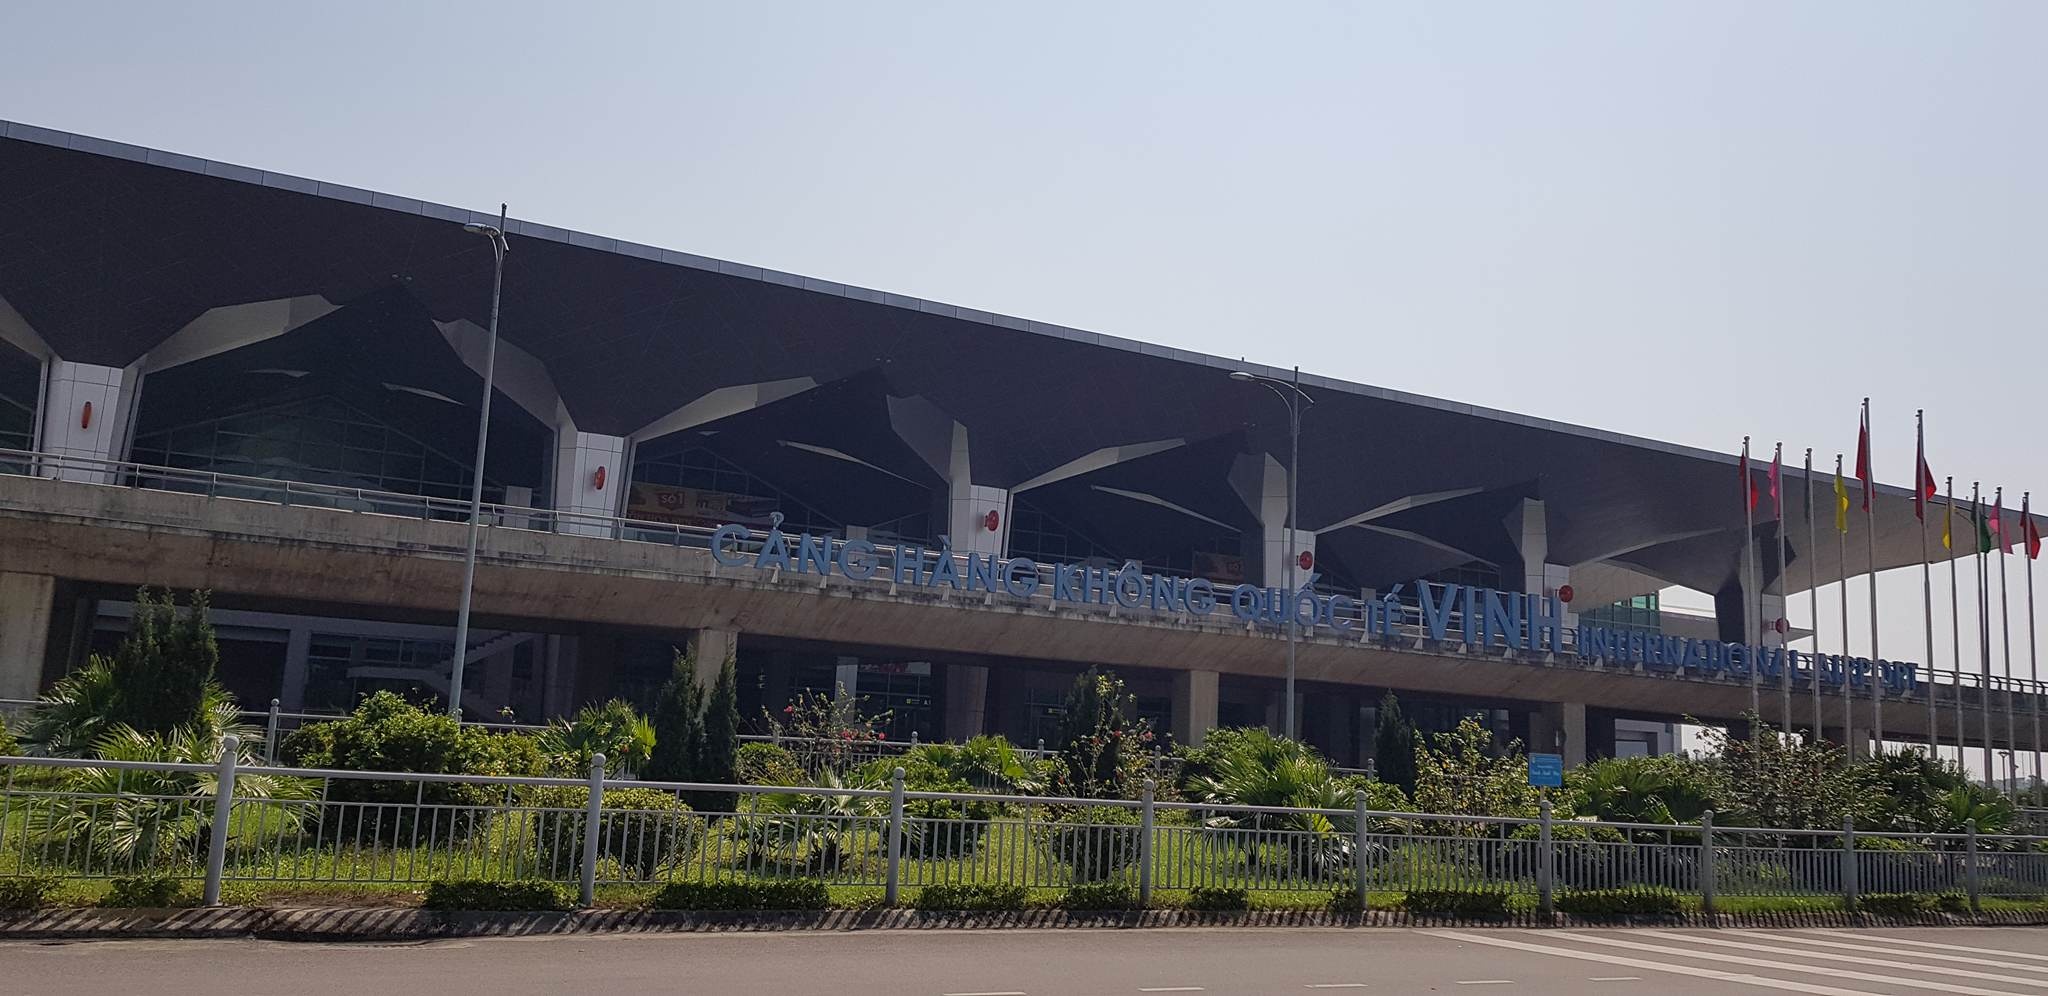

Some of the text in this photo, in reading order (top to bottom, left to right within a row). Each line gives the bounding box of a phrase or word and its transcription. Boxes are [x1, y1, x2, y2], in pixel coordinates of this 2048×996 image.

[711, 511, 1918, 690] CẢNG HÀNG KHÔNG QUỐC TẾ VINH INTERNATIONAL AIRPORT
